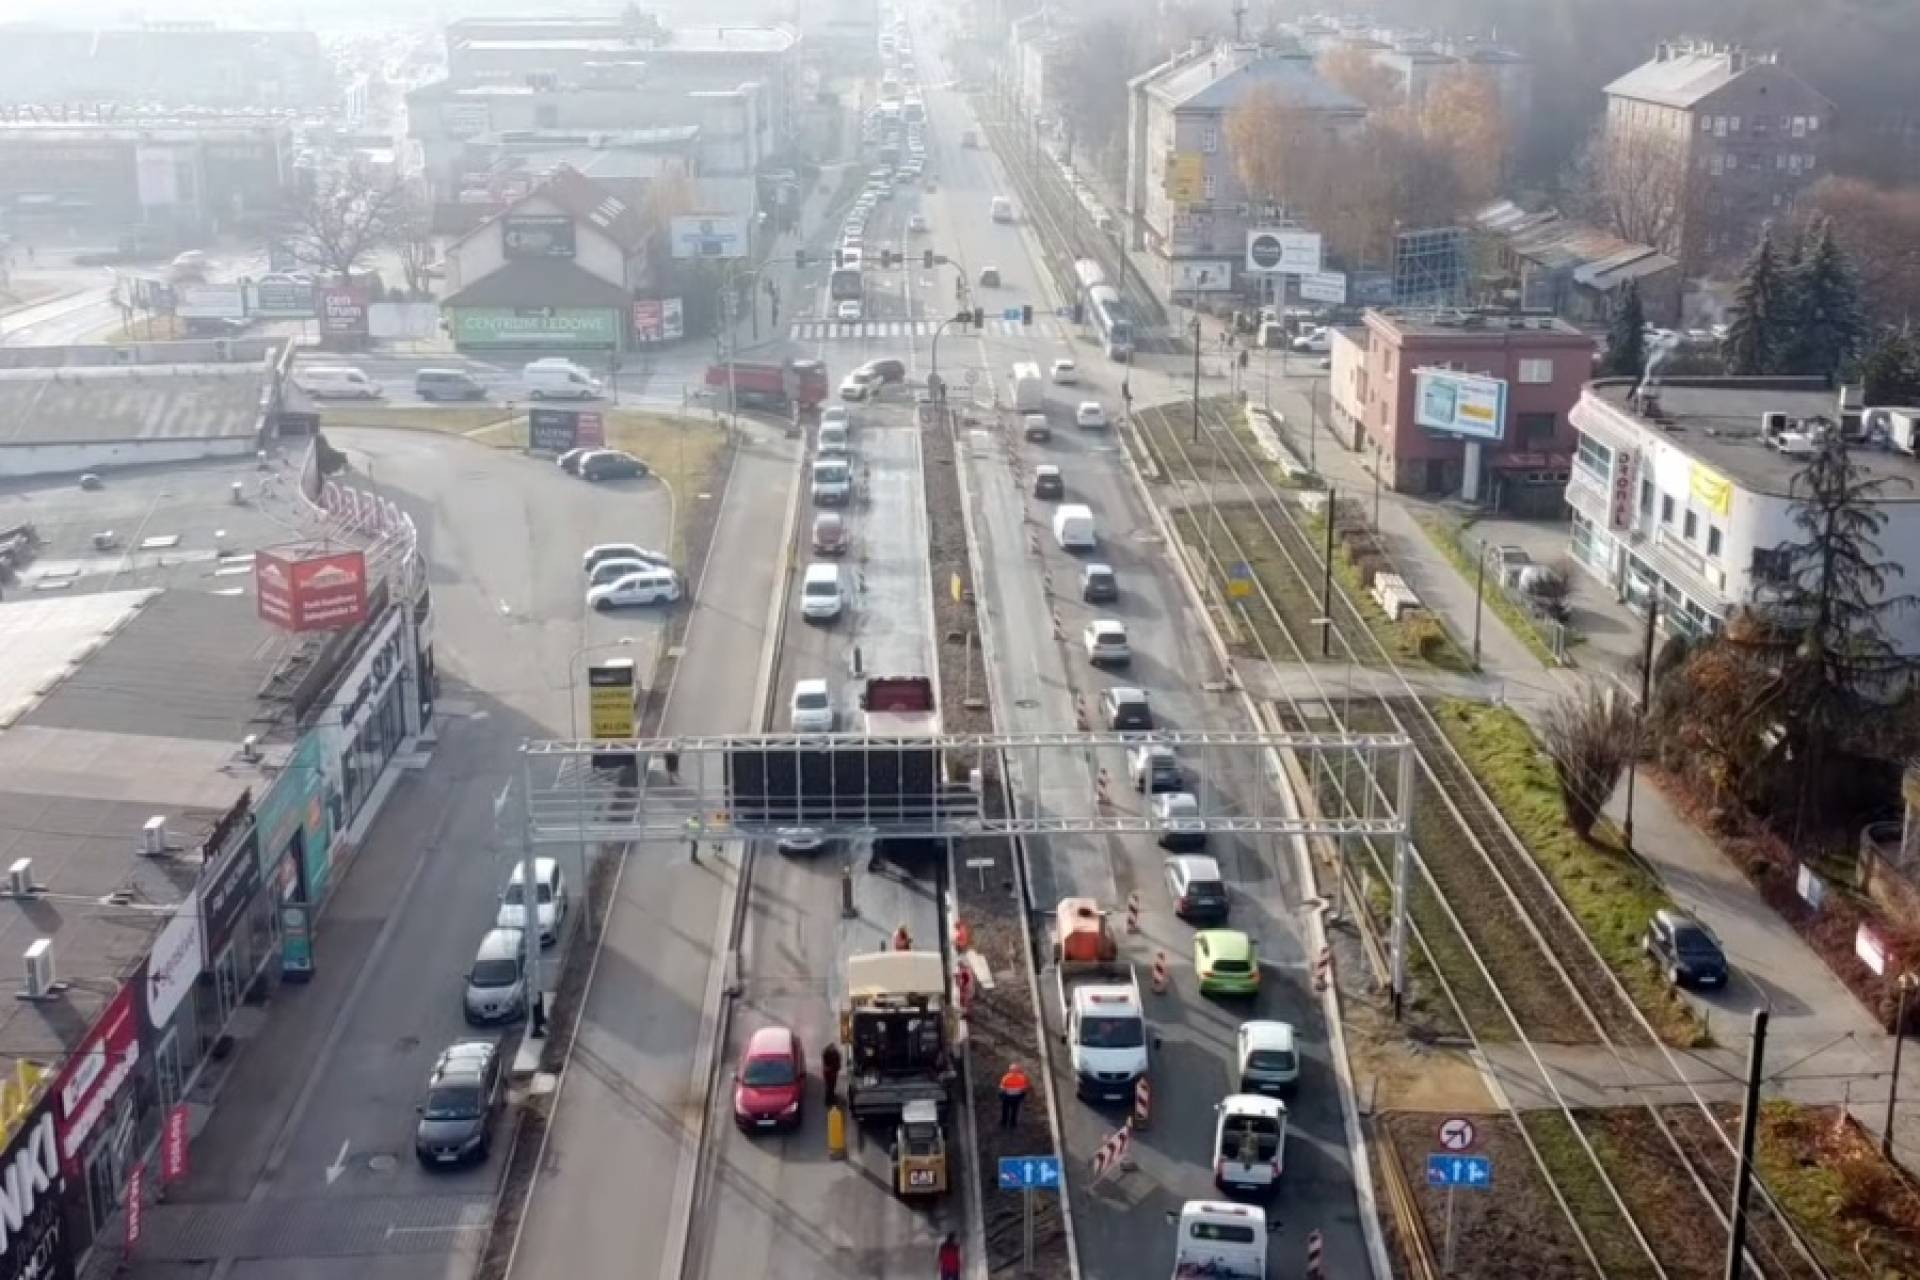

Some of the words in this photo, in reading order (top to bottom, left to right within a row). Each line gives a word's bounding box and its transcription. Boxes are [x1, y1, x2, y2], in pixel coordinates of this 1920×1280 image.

[326, 306, 362, 318] trum
[465, 316, 538, 330] CENTRUM
[543, 316, 606, 330] LEDOWE
[910, 1170, 937, 1185] CAT
